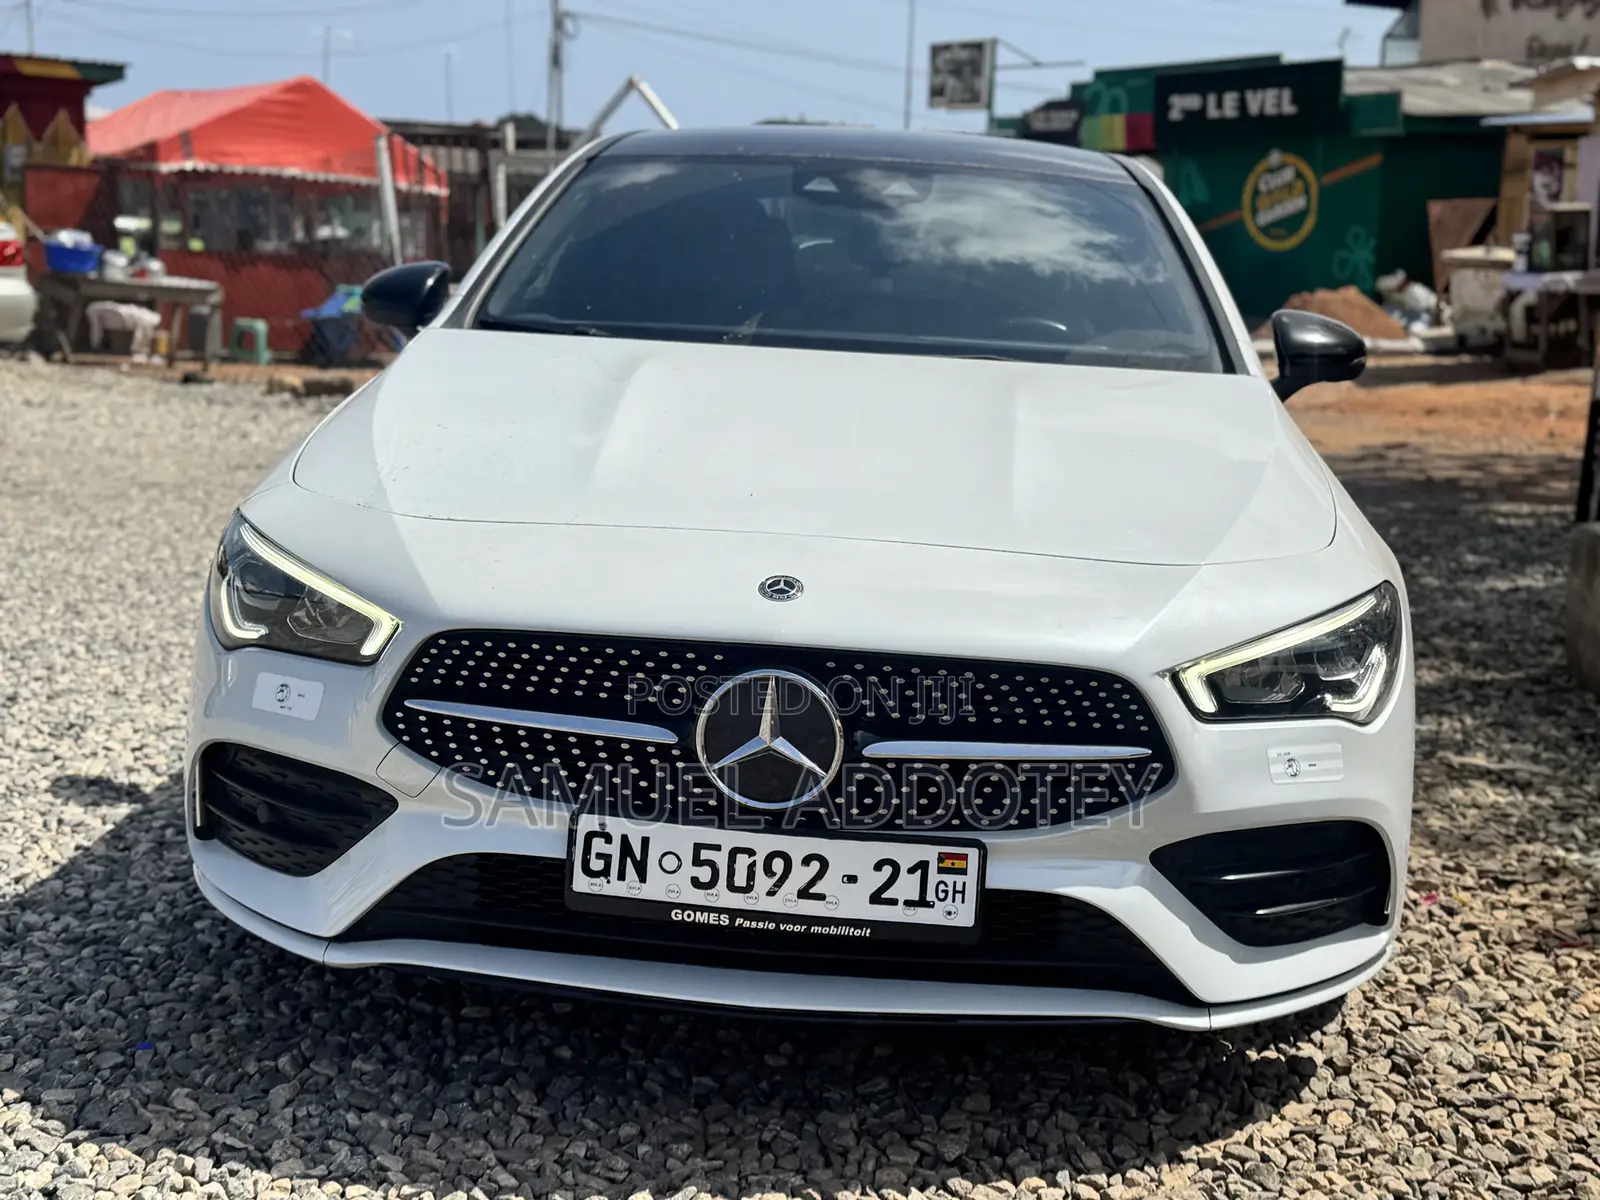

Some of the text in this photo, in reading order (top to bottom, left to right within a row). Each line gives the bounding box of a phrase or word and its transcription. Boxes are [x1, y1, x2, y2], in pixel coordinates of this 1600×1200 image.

[581, 830, 651, 884] GN
[934, 879, 967, 905] GH
[671, 909, 730, 926] GOMES
[779, 923, 807, 932] voor
